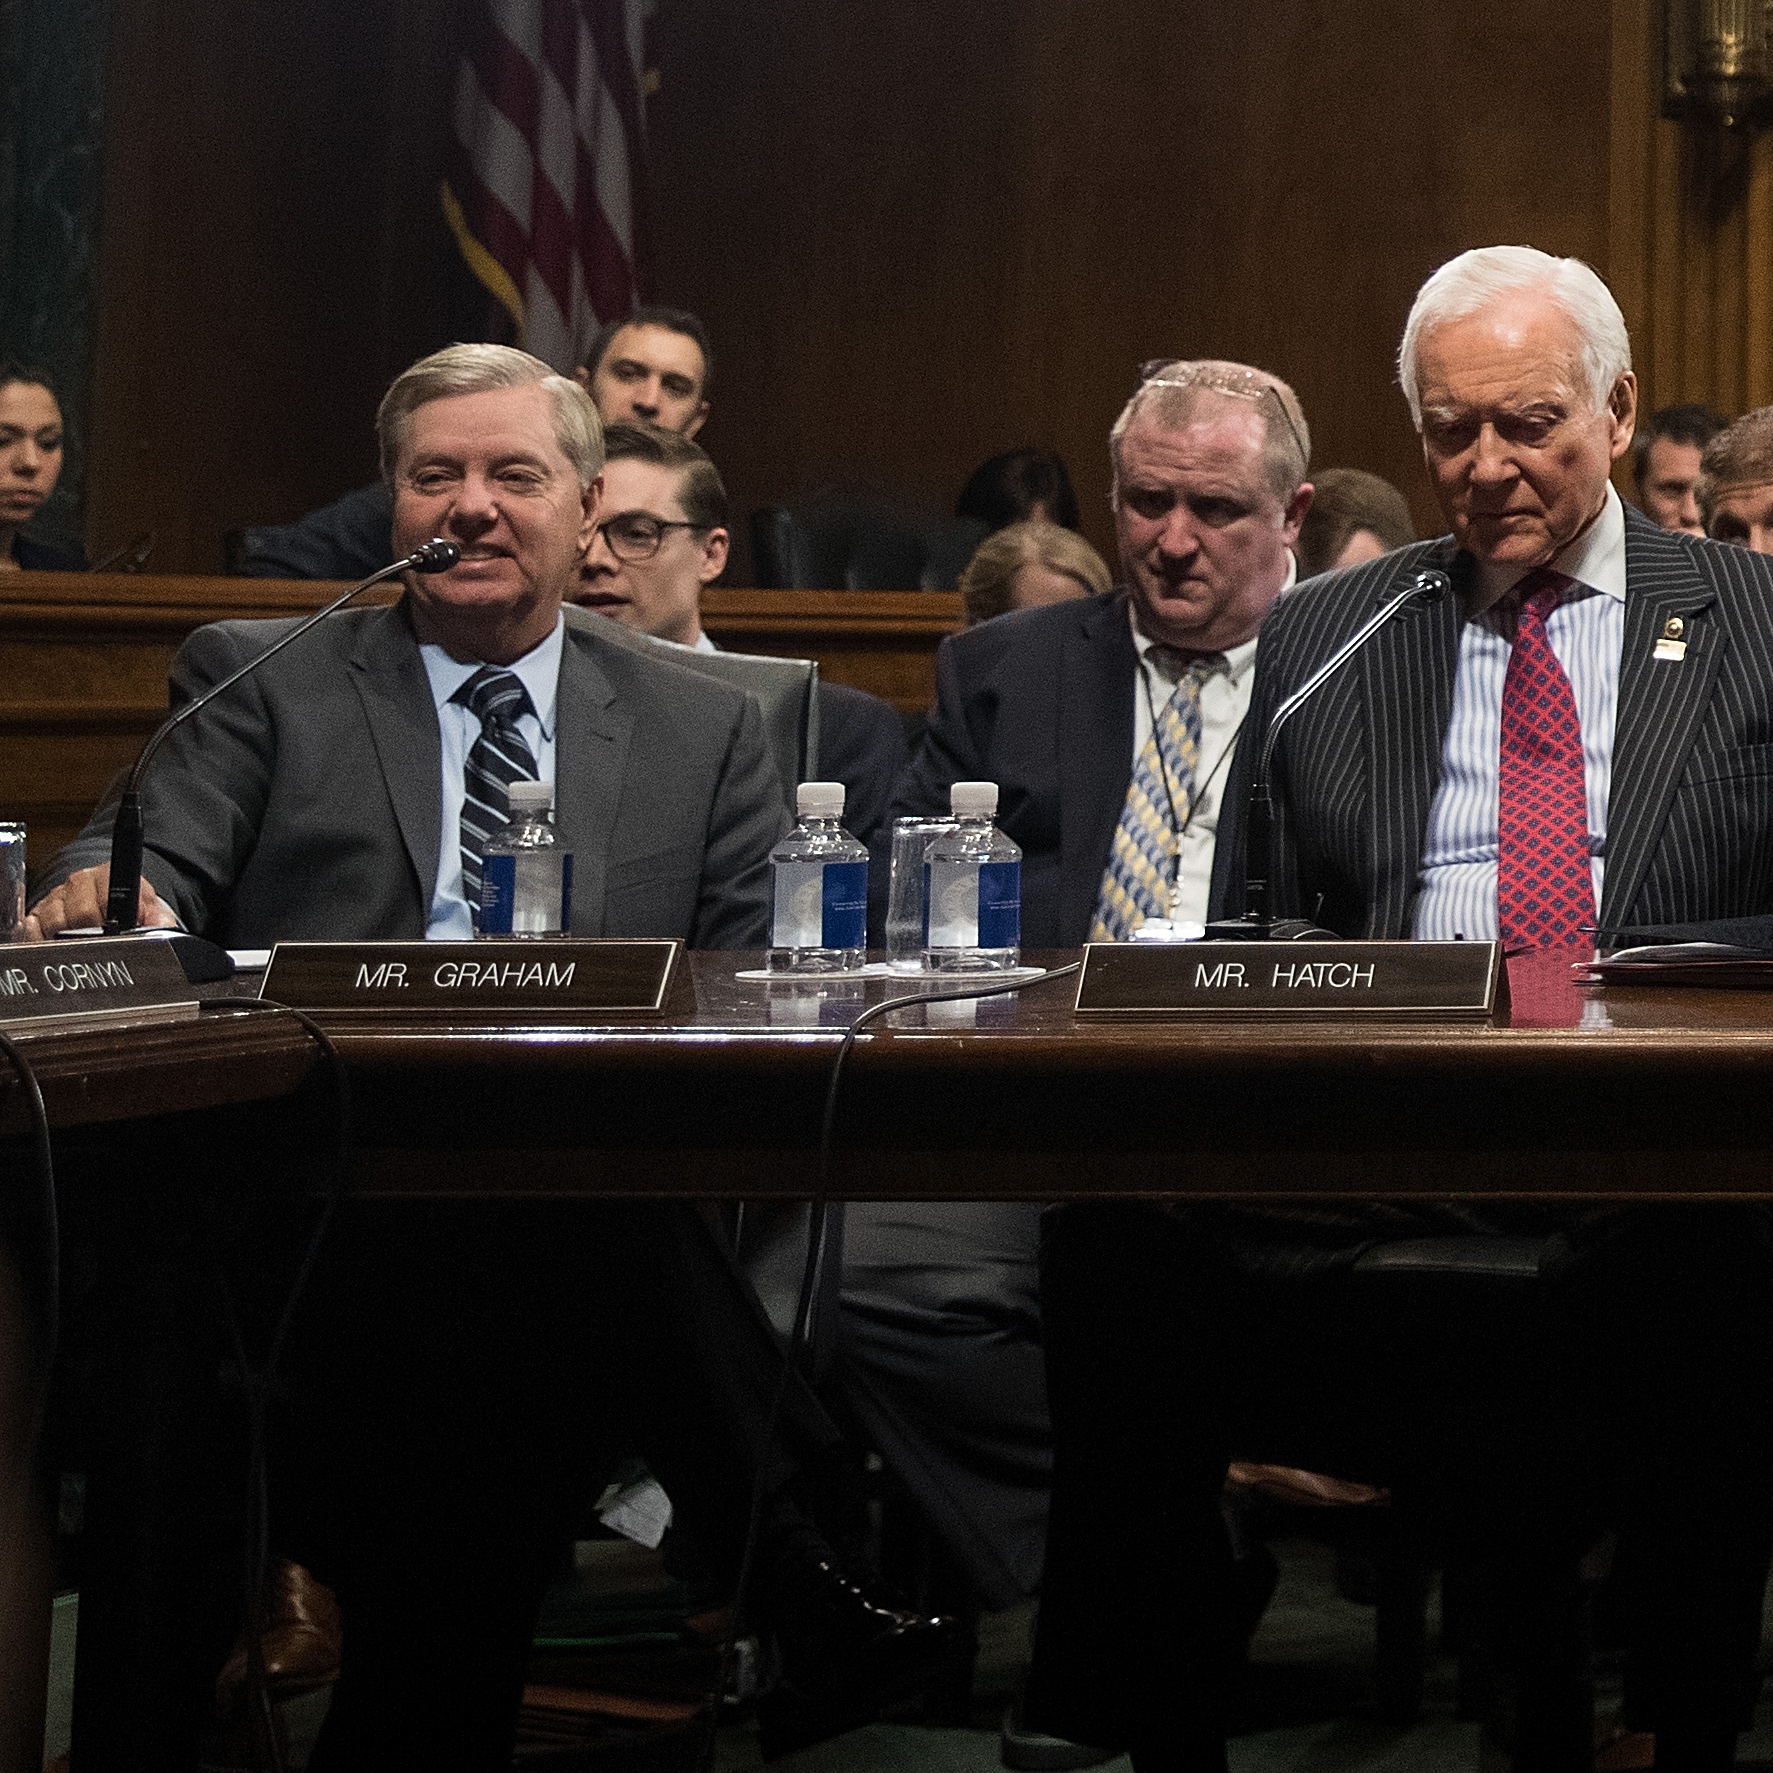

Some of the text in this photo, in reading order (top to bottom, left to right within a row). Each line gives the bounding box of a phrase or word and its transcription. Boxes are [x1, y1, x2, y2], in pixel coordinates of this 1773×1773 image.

[0, 961, 135, 996] MR. CORNYN
[355, 962, 576, 988] MR. GRAHAM
[1194, 962, 1375, 988] MR. HATCH
